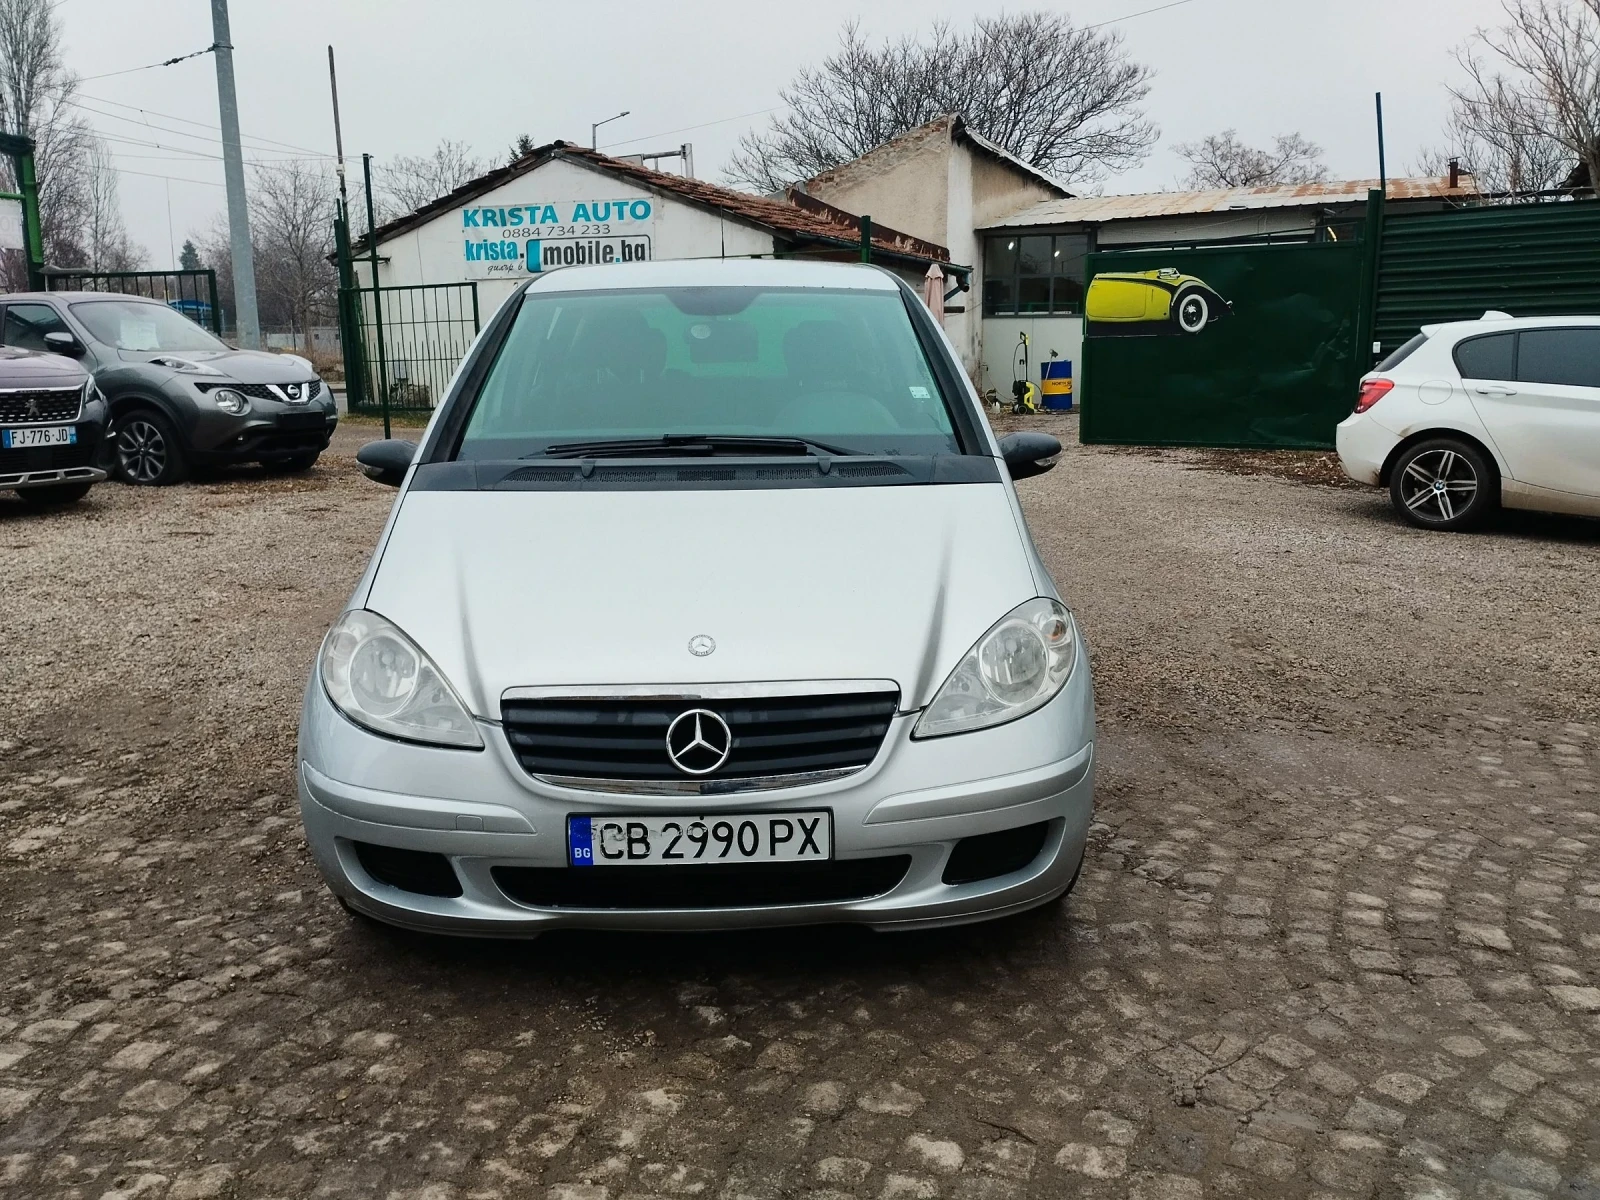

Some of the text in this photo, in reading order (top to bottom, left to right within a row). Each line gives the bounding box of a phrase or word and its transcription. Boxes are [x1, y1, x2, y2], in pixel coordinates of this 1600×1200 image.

[463, 200, 652, 228] KRISTA AUTO
[502, 223, 612, 239] 0884 734 233
[599, 817, 822, 860] CB 2990 PX
[574, 847, 591, 859] BG
